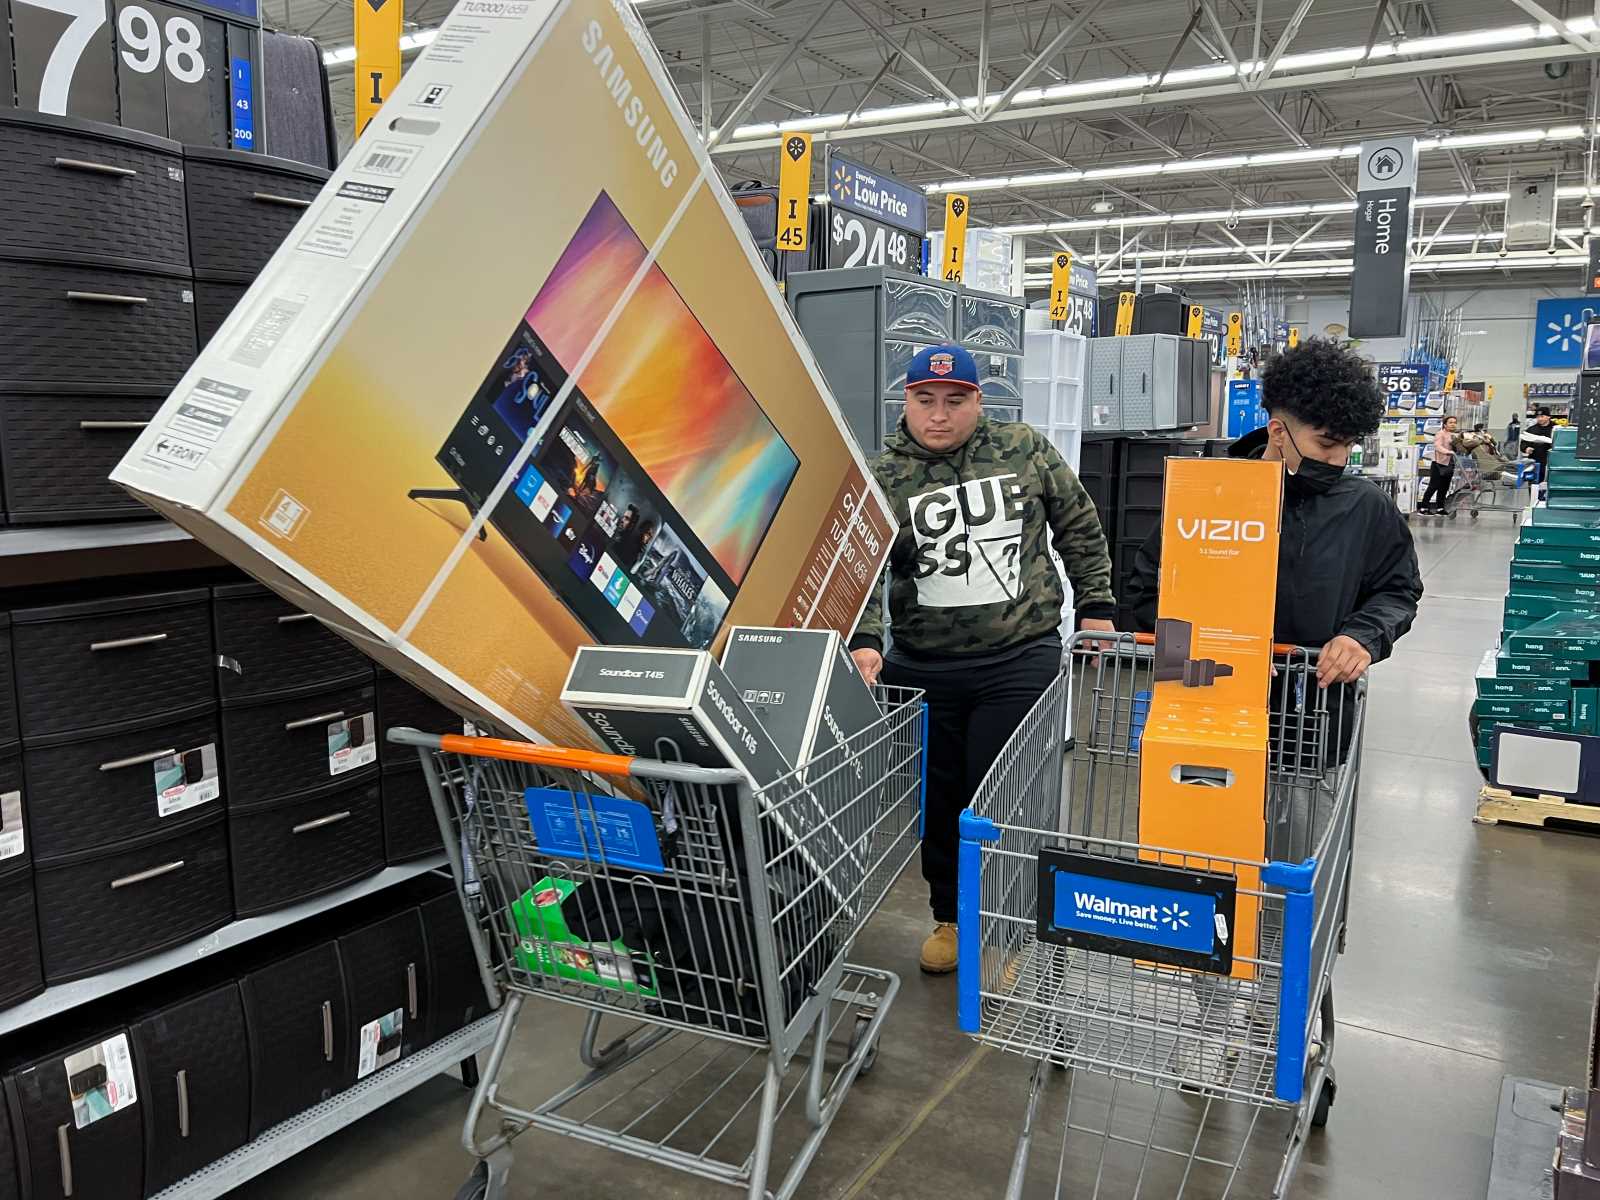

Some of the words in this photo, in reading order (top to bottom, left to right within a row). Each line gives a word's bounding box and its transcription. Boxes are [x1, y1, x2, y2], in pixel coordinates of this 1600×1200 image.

[371, 72, 383, 104] I
[236, 98, 249, 110] 43
[581, 19, 678, 189] SAMSUNG
[234, 129, 252, 140] 200
[856, 170, 877, 187] Everyday
[854, 179, 879, 206] Low
[880, 190, 908, 217] Price
[787, 199, 798, 219] I
[1367, 200, 1375, 223] Hogar
[1375, 198, 1397, 255] Home
[780, 227, 803, 246] 45
[951, 247, 958, 263] I
[945, 270, 961, 284] 46
[1074, 274, 1089, 289] Price
[1057, 290, 1063, 302] I
[1052, 306, 1065, 317] 47
[1228, 347, 1237, 356] 50
[1383, 376, 1411, 391] $56
[166, 444, 204, 464] FRONT
[843, 493, 869, 538] Crtal
[1177, 518, 1265, 542] VIZIO
[830, 517, 856, 563] TU700
[1575, 588, 1595, 597] hang
[737, 633, 783, 643] SAMSUNG
[1525, 643, 1544, 651] hang
[599, 667, 641, 679] Soundbar
[644, 670, 664, 680] T415
[1511, 663, 1531, 671] hang
[1494, 684, 1514, 692] hang
[1491, 705, 1510, 713] hang
[706, 680, 743, 734] Soundbar
[740, 726, 757, 755] T415
[587, 711, 637, 756] Soundb
[1074, 891, 1158, 922] Walmart
[1075, 909, 1092, 919] Save
[1092, 913, 1118, 925] money.
[1119, 917, 1134, 926] Live
[1134, 919, 1159, 931] better.
